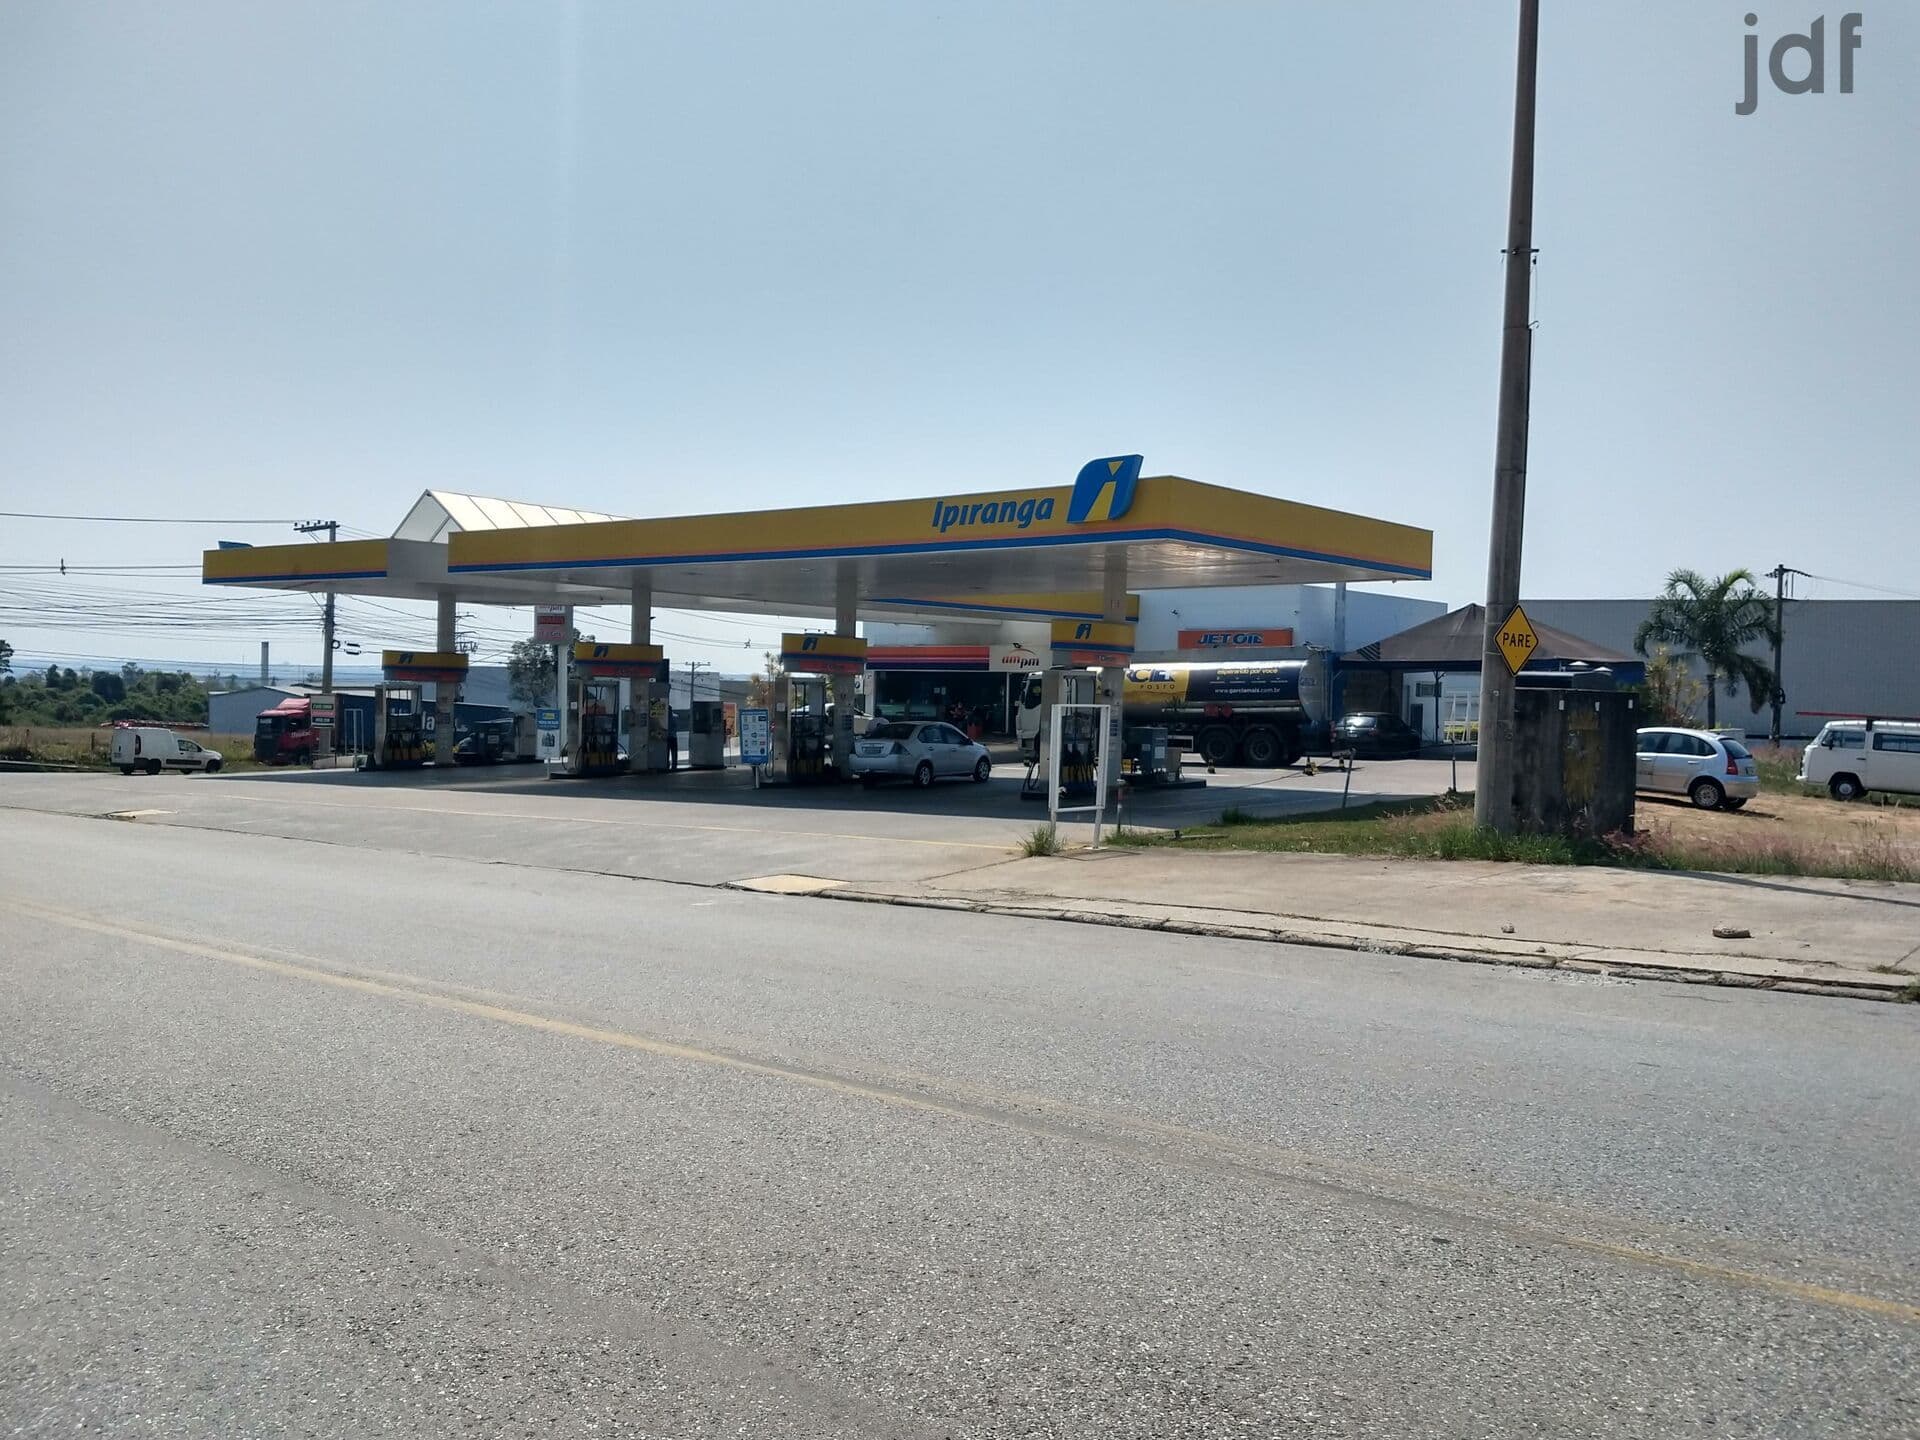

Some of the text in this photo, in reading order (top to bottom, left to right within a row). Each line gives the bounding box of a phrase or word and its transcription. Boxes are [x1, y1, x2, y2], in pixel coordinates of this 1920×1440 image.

[932, 498, 1055, 533] Ipiranga
[1198, 633, 1231, 645] JET
[1502, 632, 1532, 648] PARE
